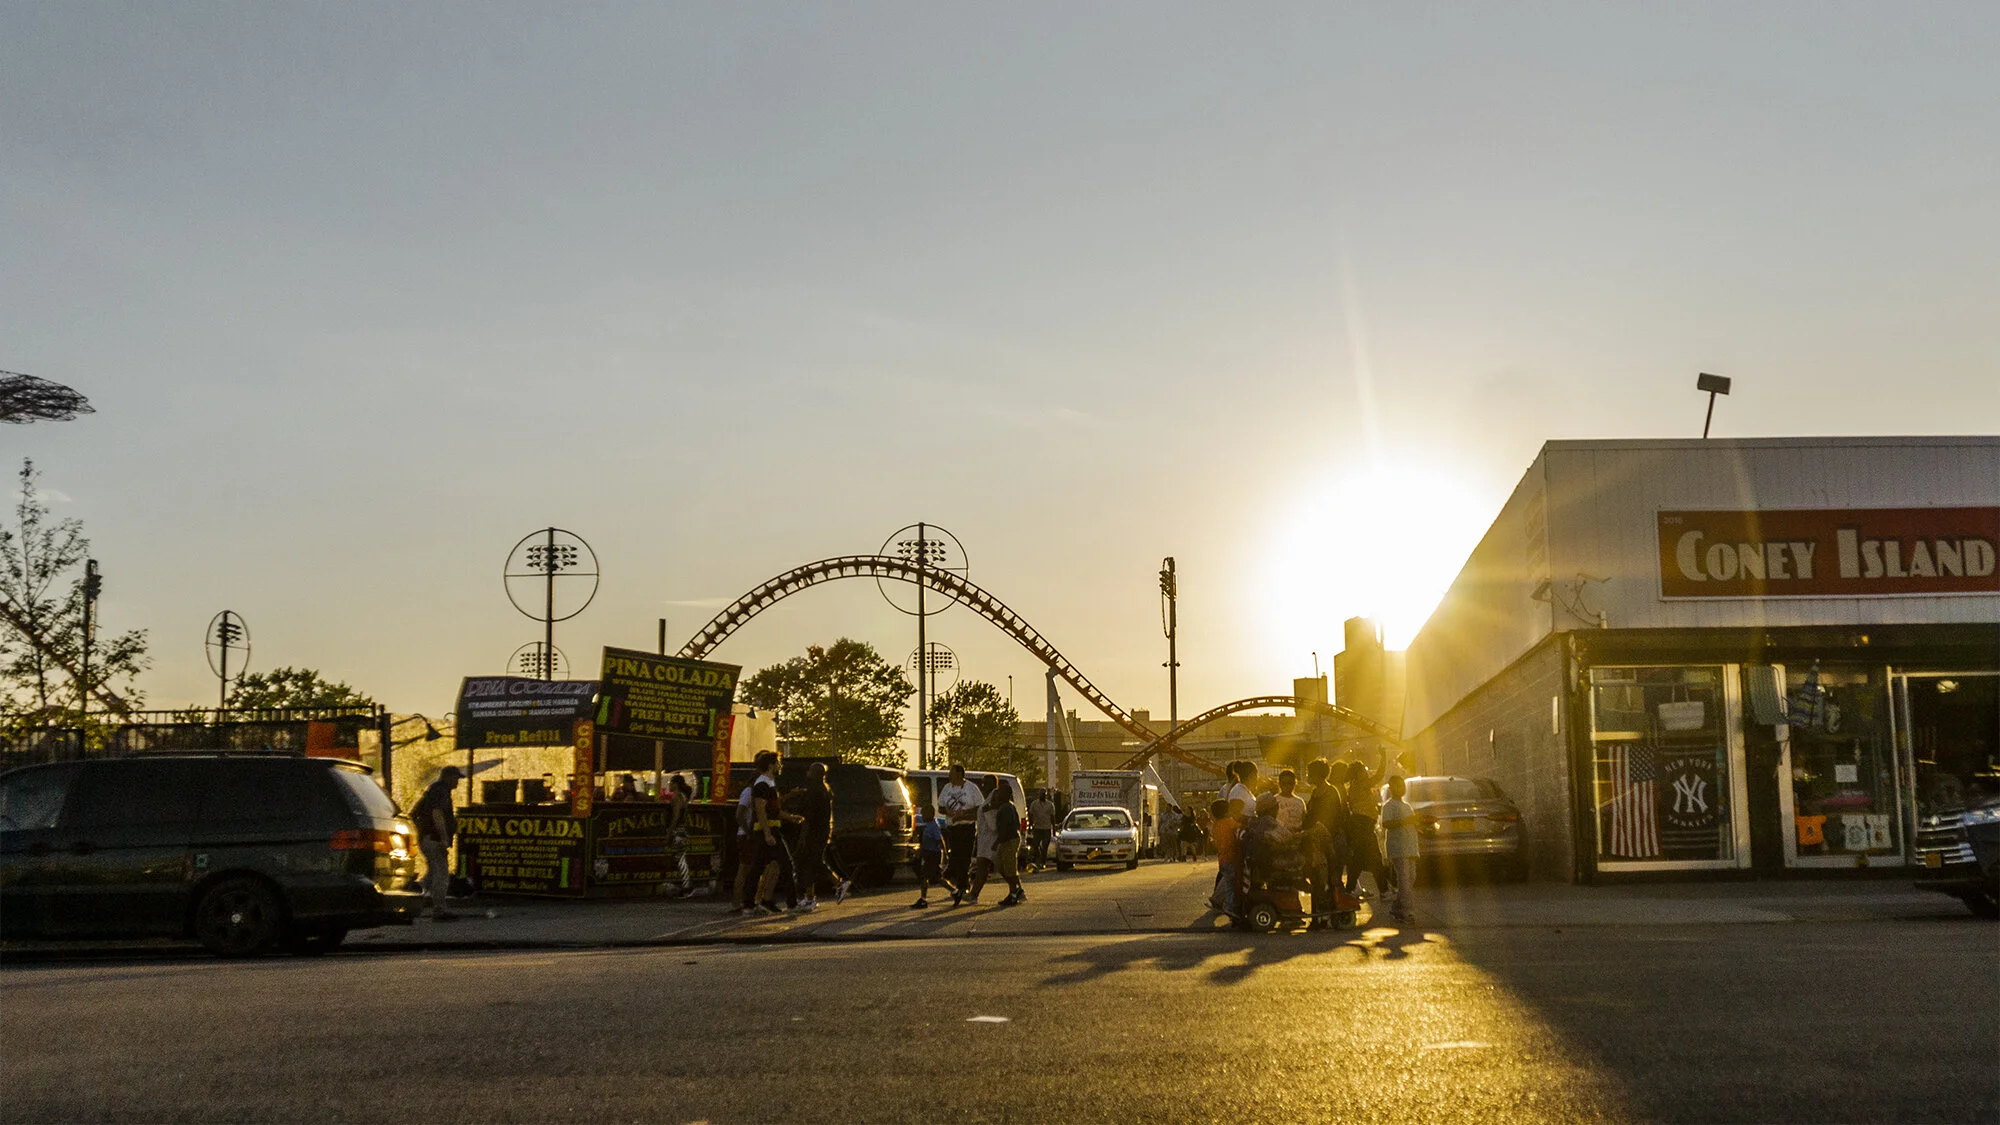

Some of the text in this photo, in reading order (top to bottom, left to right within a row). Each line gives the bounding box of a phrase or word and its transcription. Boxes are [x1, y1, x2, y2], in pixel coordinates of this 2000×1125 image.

[1676, 528, 1996, 582] CONEY ISLAND
[606, 657, 732, 689] PINA COLADA
[465, 680, 591, 697] PINA COLADA
[630, 709, 704, 725] FREE REFILL
[486, 729, 560, 743] Free Refill
[576, 723, 591, 811] COLADAS
[1665, 758, 1712, 772] NEW YORK
[456, 817, 584, 838] PINA COLADA
[1668, 814, 1713, 828] YANKEES
[481, 866, 555, 879] FREE REFILL
